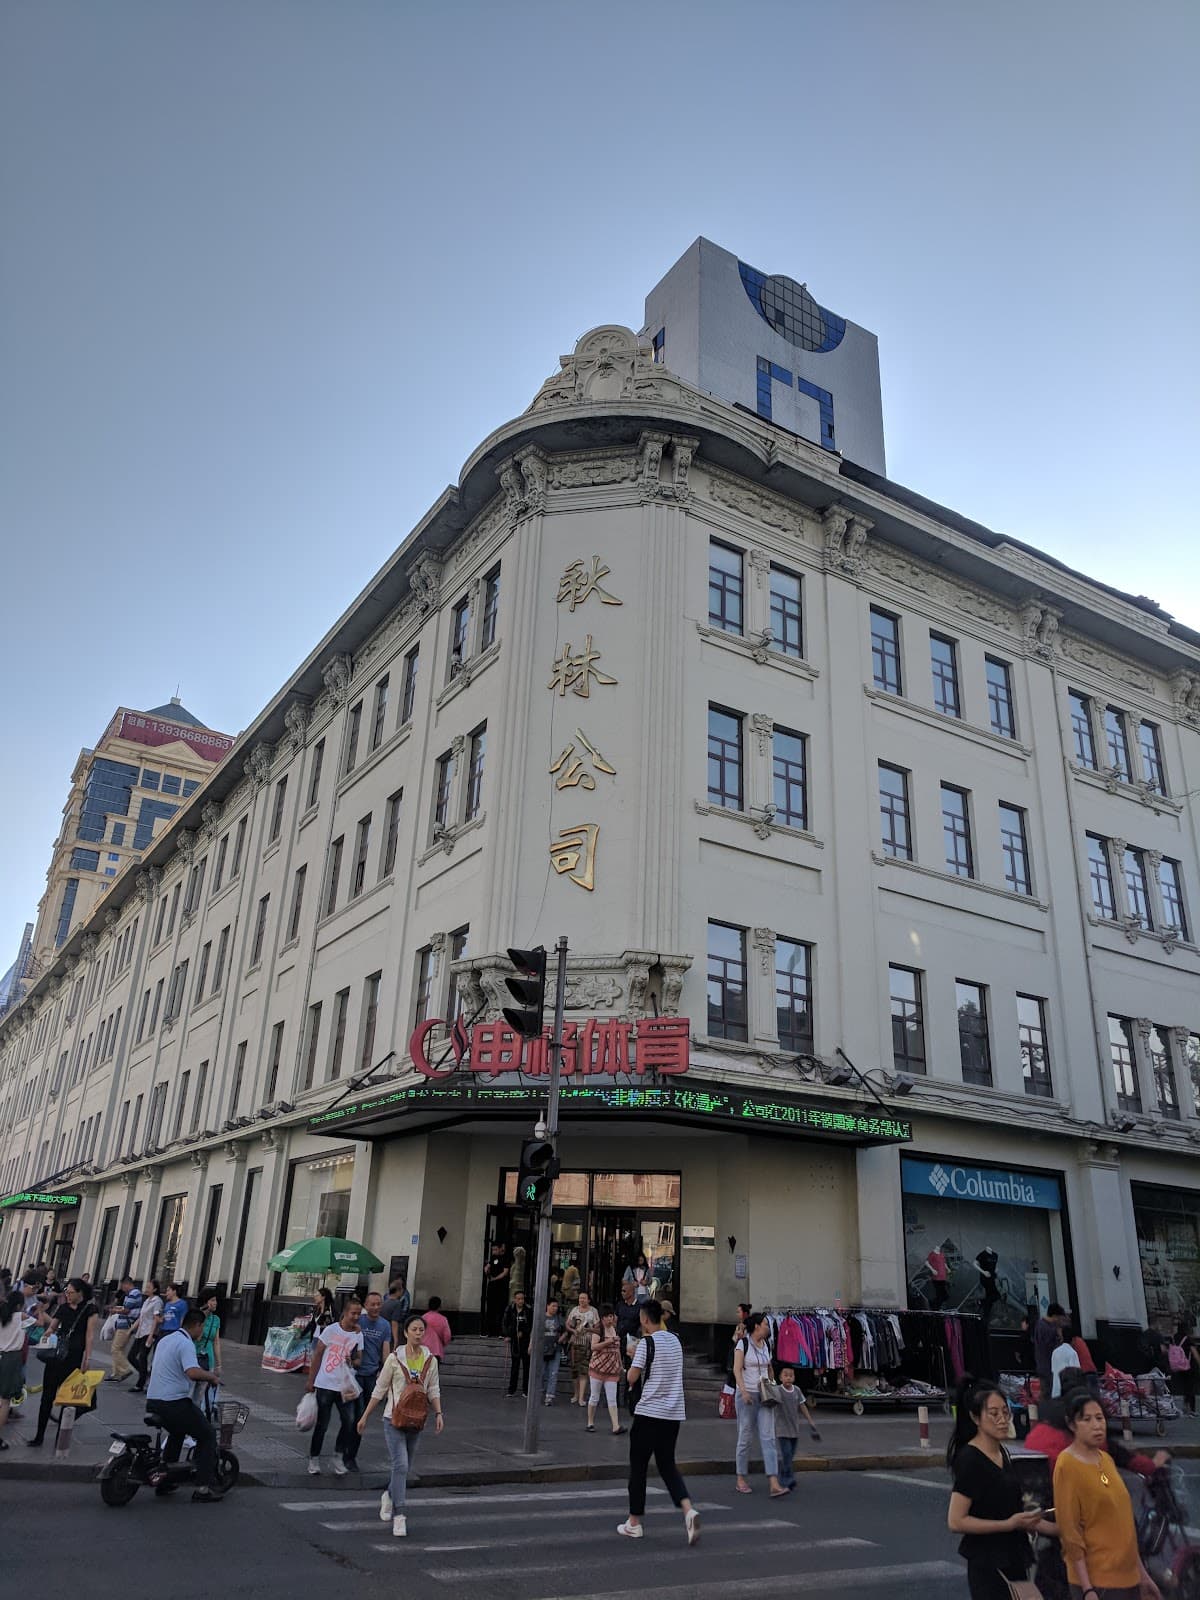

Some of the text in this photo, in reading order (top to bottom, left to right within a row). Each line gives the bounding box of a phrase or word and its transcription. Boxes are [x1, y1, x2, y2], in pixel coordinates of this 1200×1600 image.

[547, 554, 623, 891] 秋林公司
[950, 1167, 1036, 1204] Columbia
